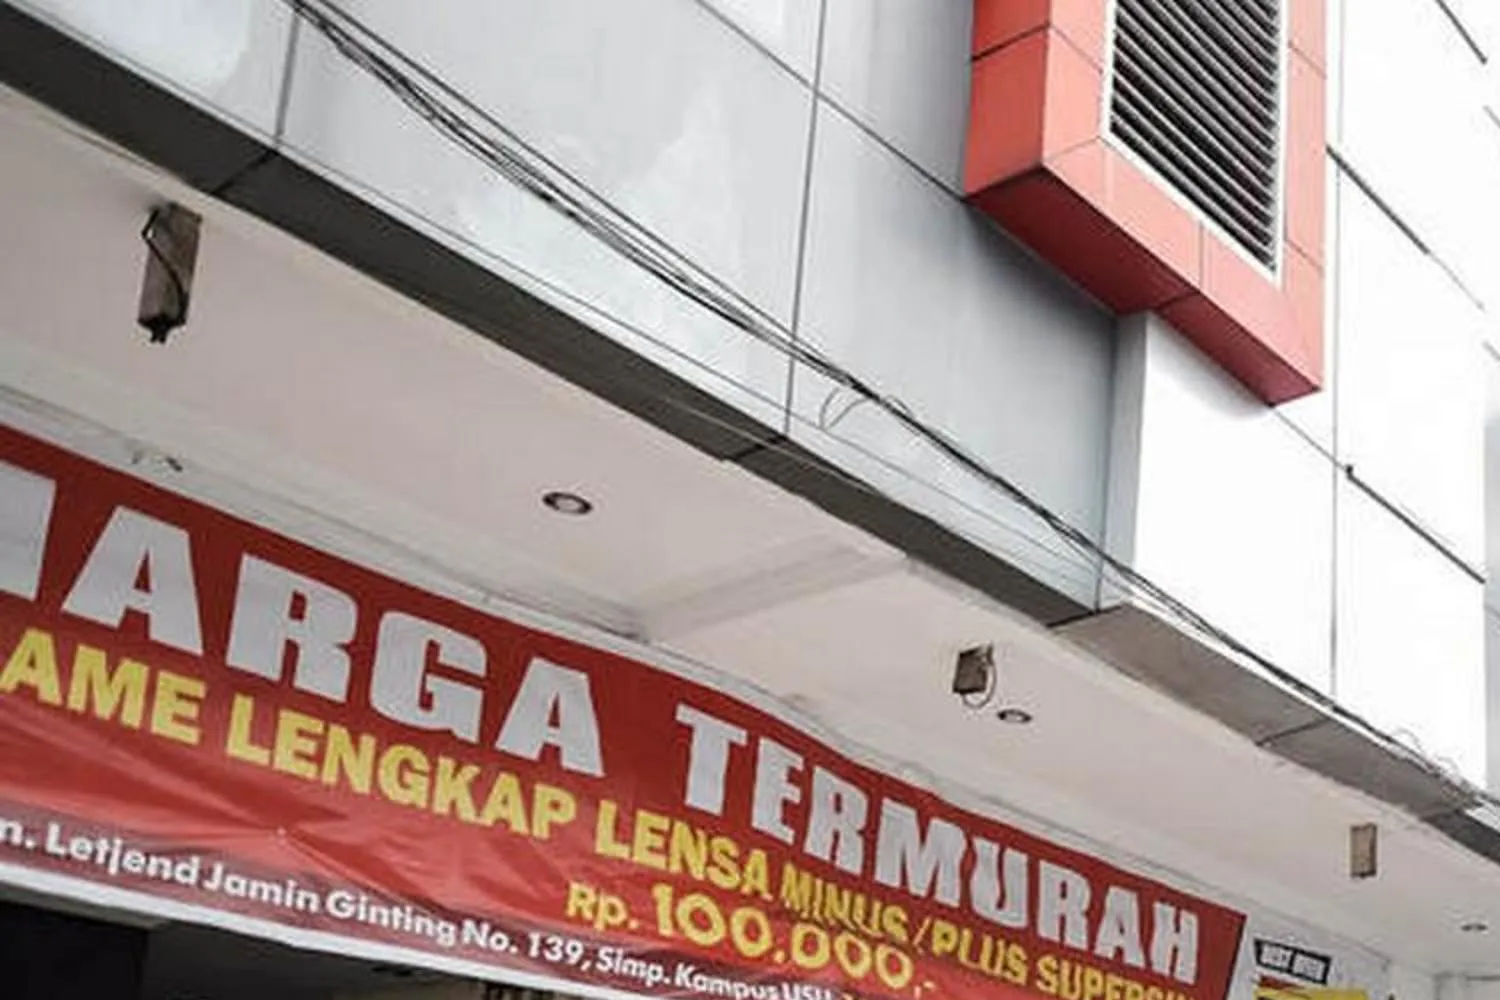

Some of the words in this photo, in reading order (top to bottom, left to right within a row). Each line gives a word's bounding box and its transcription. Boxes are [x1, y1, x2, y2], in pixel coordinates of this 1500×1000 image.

[0, 627, 207, 746] AME
[225, 695, 577, 841] LENGKAP
[595, 799, 773, 901] LENSA
[675, 703, 1199, 984] TERMURAH
[45, 821, 201, 885] Letjend
[203, 861, 320, 914] Jamin
[326, 888, 456, 947] Ginting
[462, 919, 518, 955] No.
[595, 945, 671, 987] Simp.
[567, 880, 640, 931] Rp.
